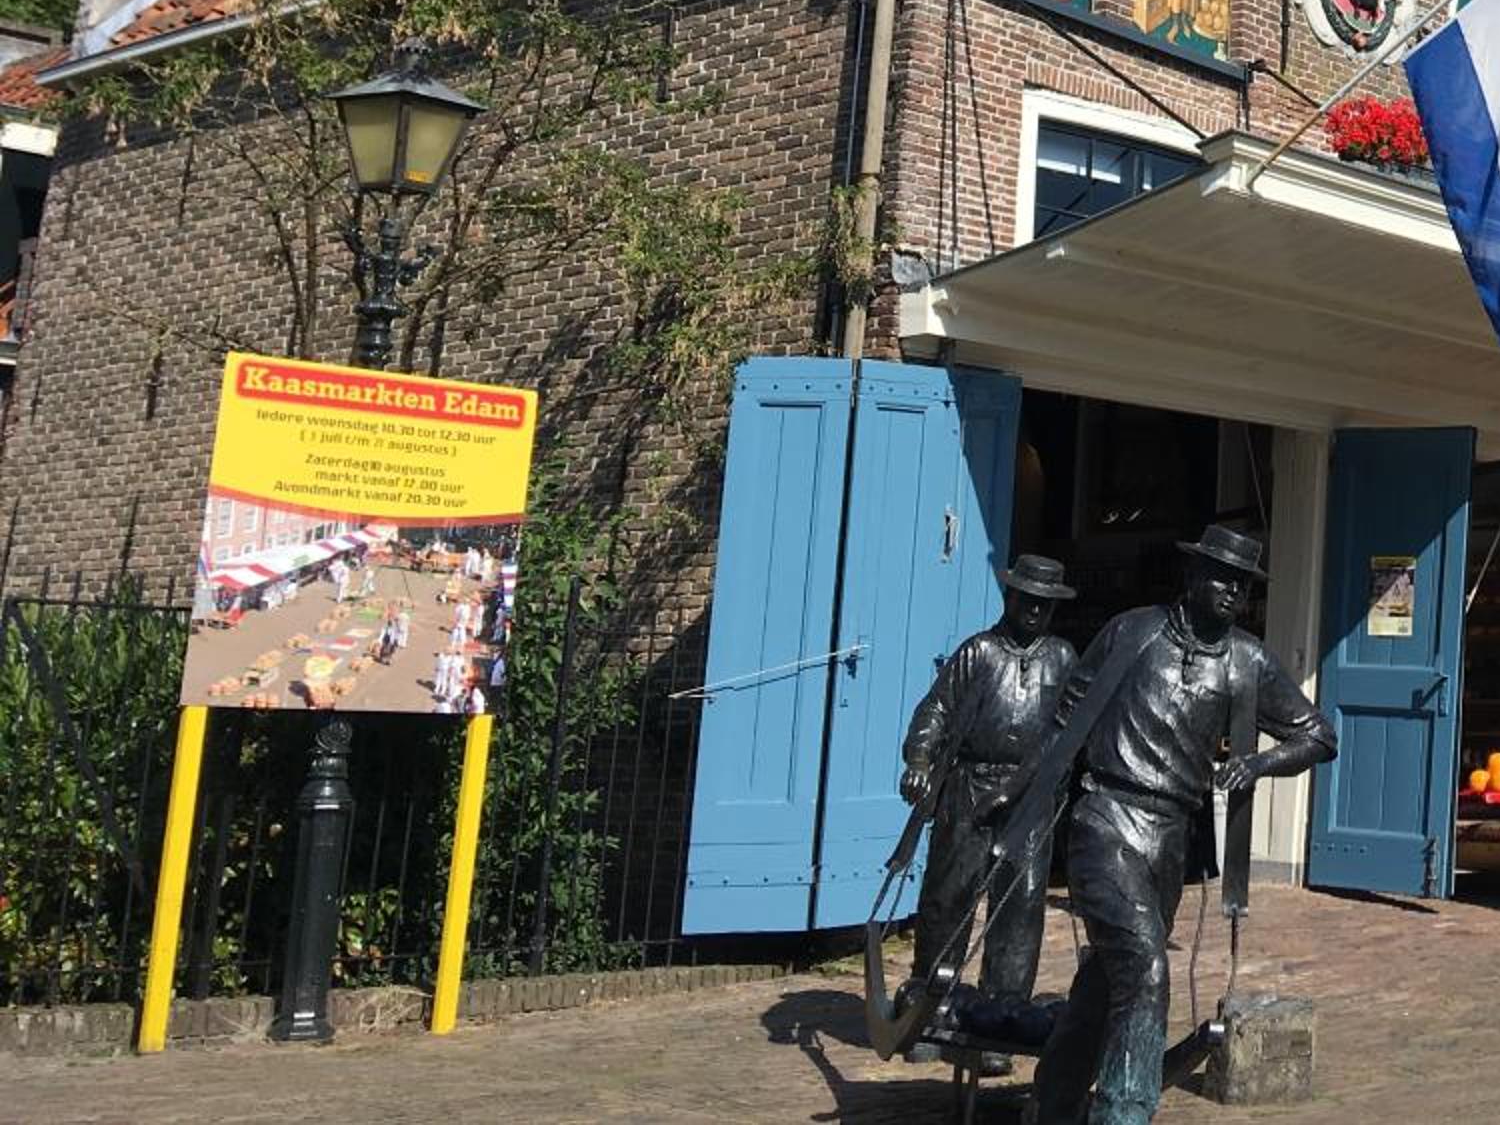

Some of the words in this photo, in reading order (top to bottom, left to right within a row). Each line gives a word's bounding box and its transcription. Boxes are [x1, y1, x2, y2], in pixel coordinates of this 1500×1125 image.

[242, 365, 437, 412] Kaasmarkten
[444, 391, 521, 422] Edam
[307, 416, 378, 434] woensdag
[417, 428, 437, 439] tot
[440, 429, 471, 442] 12.30
[473, 435, 496, 445] uur
[319, 431, 342, 443] juli
[315, 470, 357, 484] markt
[361, 475, 401, 488] vanaf
[440, 483, 464, 493] uur
[384, 462, 446, 477] augustus
[273, 480, 361, 499] Avondmarkt
[364, 489, 402, 503] vanaf
[405, 493, 441, 506] 20.30
[443, 497, 468, 508] uur
